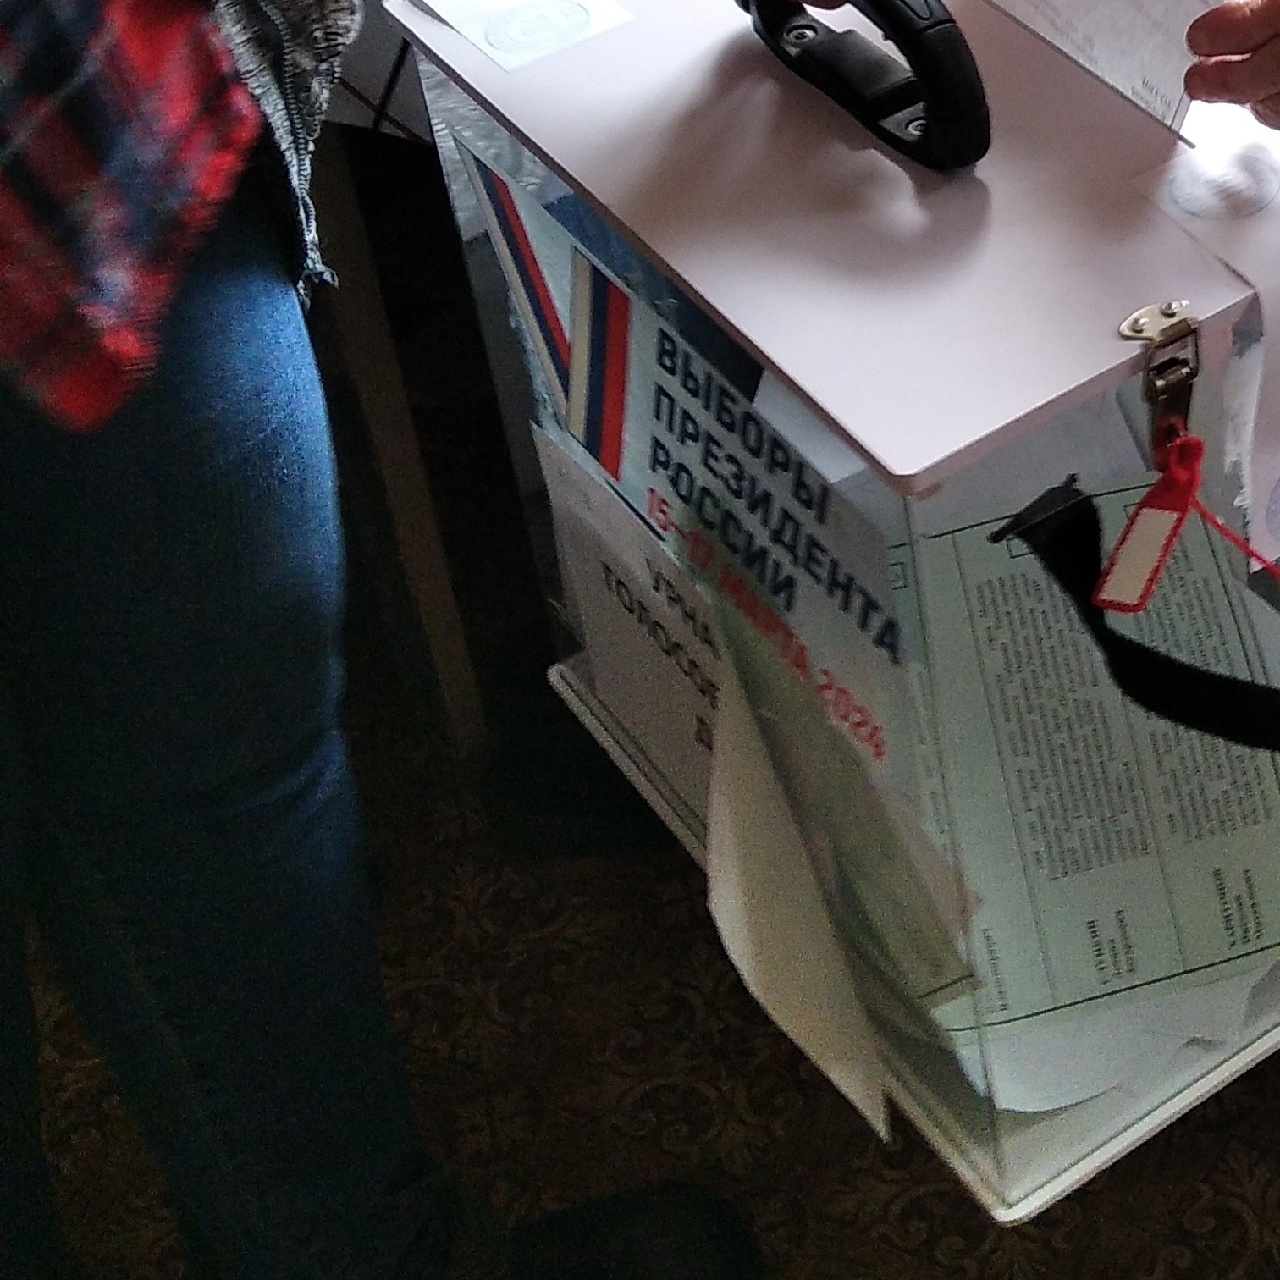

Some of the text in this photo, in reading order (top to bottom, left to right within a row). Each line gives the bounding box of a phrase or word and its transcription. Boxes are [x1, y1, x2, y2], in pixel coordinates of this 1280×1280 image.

[649, 436, 796, 613] РОССИИ
[652, 382, 903, 666] ПРЕЗИДЕНТА
[656, 327, 829, 526] ВЫБОРЫ
